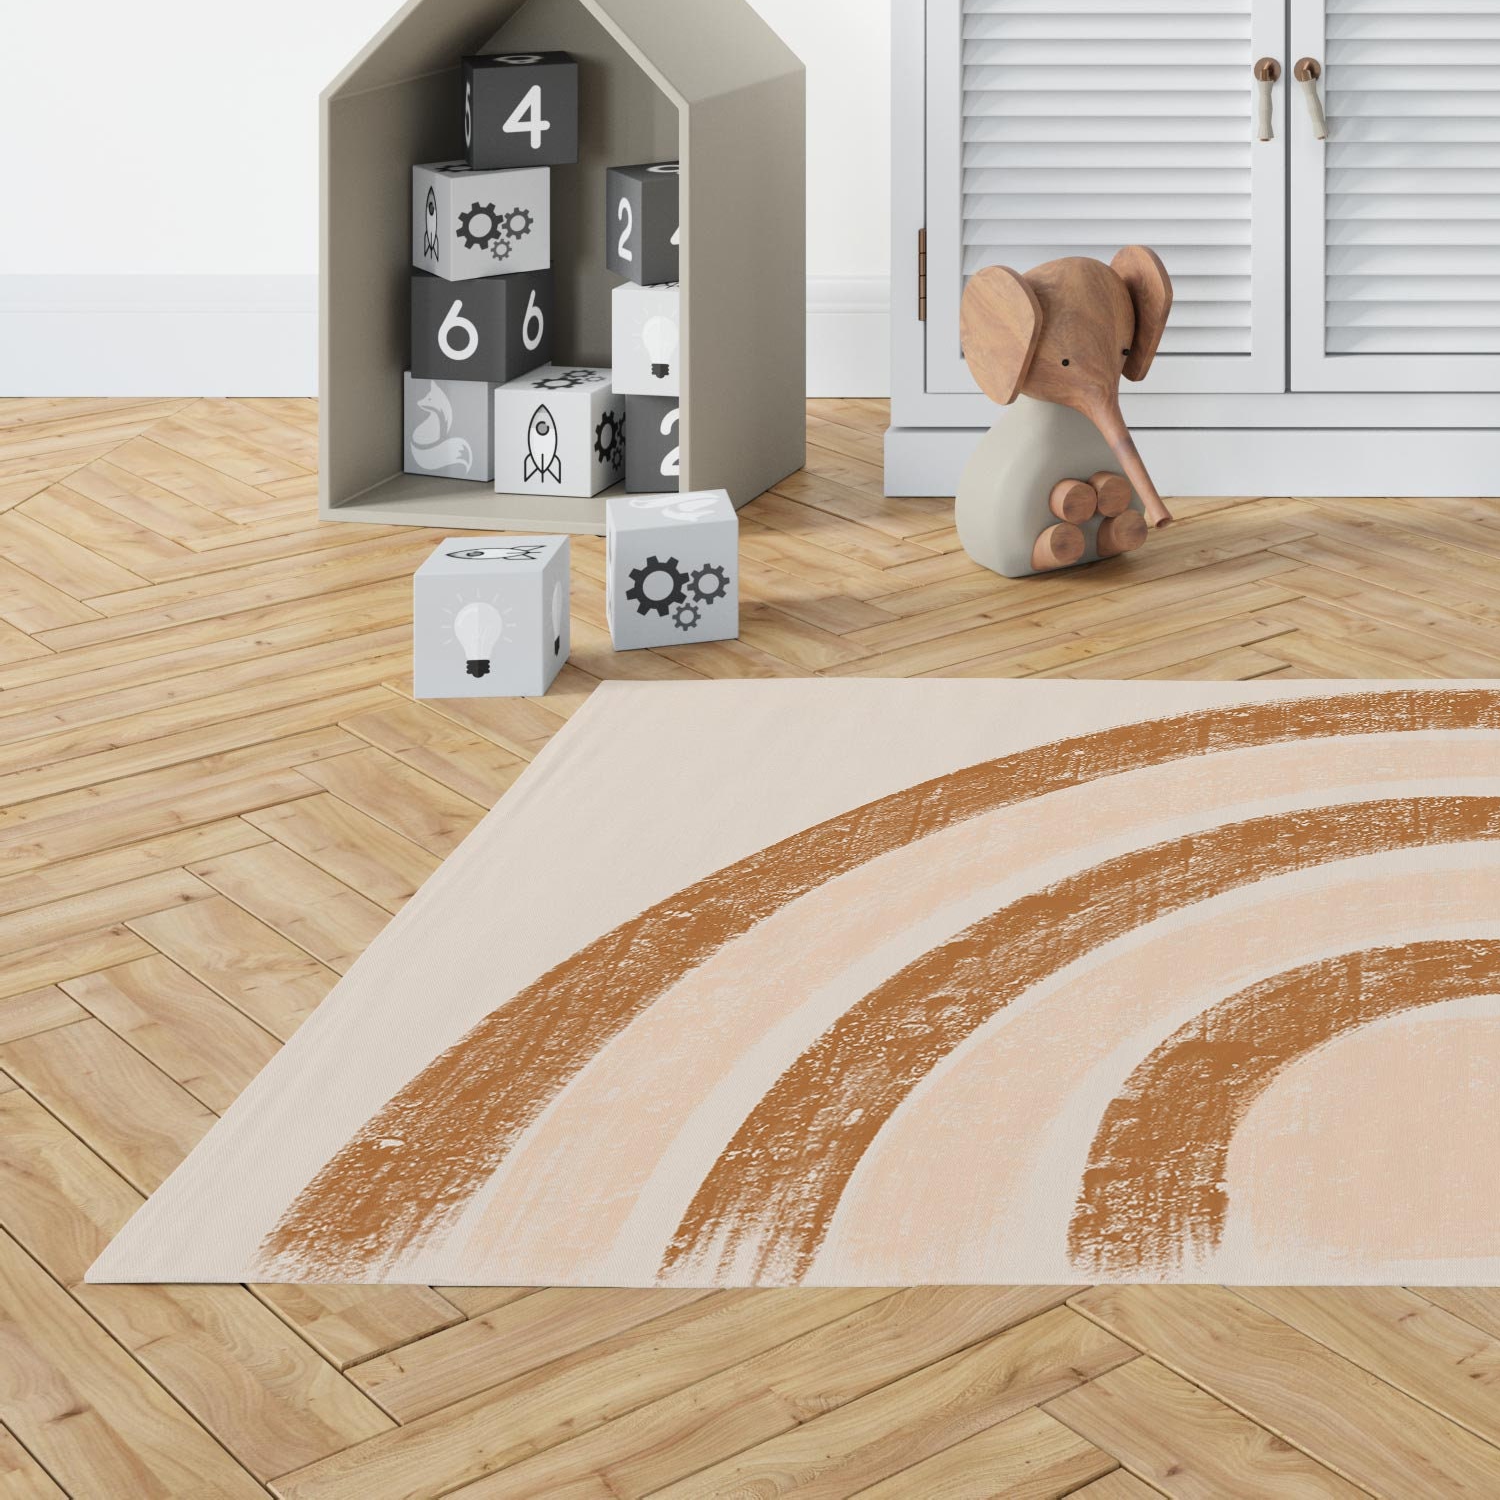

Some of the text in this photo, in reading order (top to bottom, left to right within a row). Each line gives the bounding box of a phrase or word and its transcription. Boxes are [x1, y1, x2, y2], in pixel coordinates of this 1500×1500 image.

[502, 84, 551, 150] 4
[617, 196, 633, 262] 2
[437, 299, 479, 361] 6
[522, 288, 544, 351] 6
